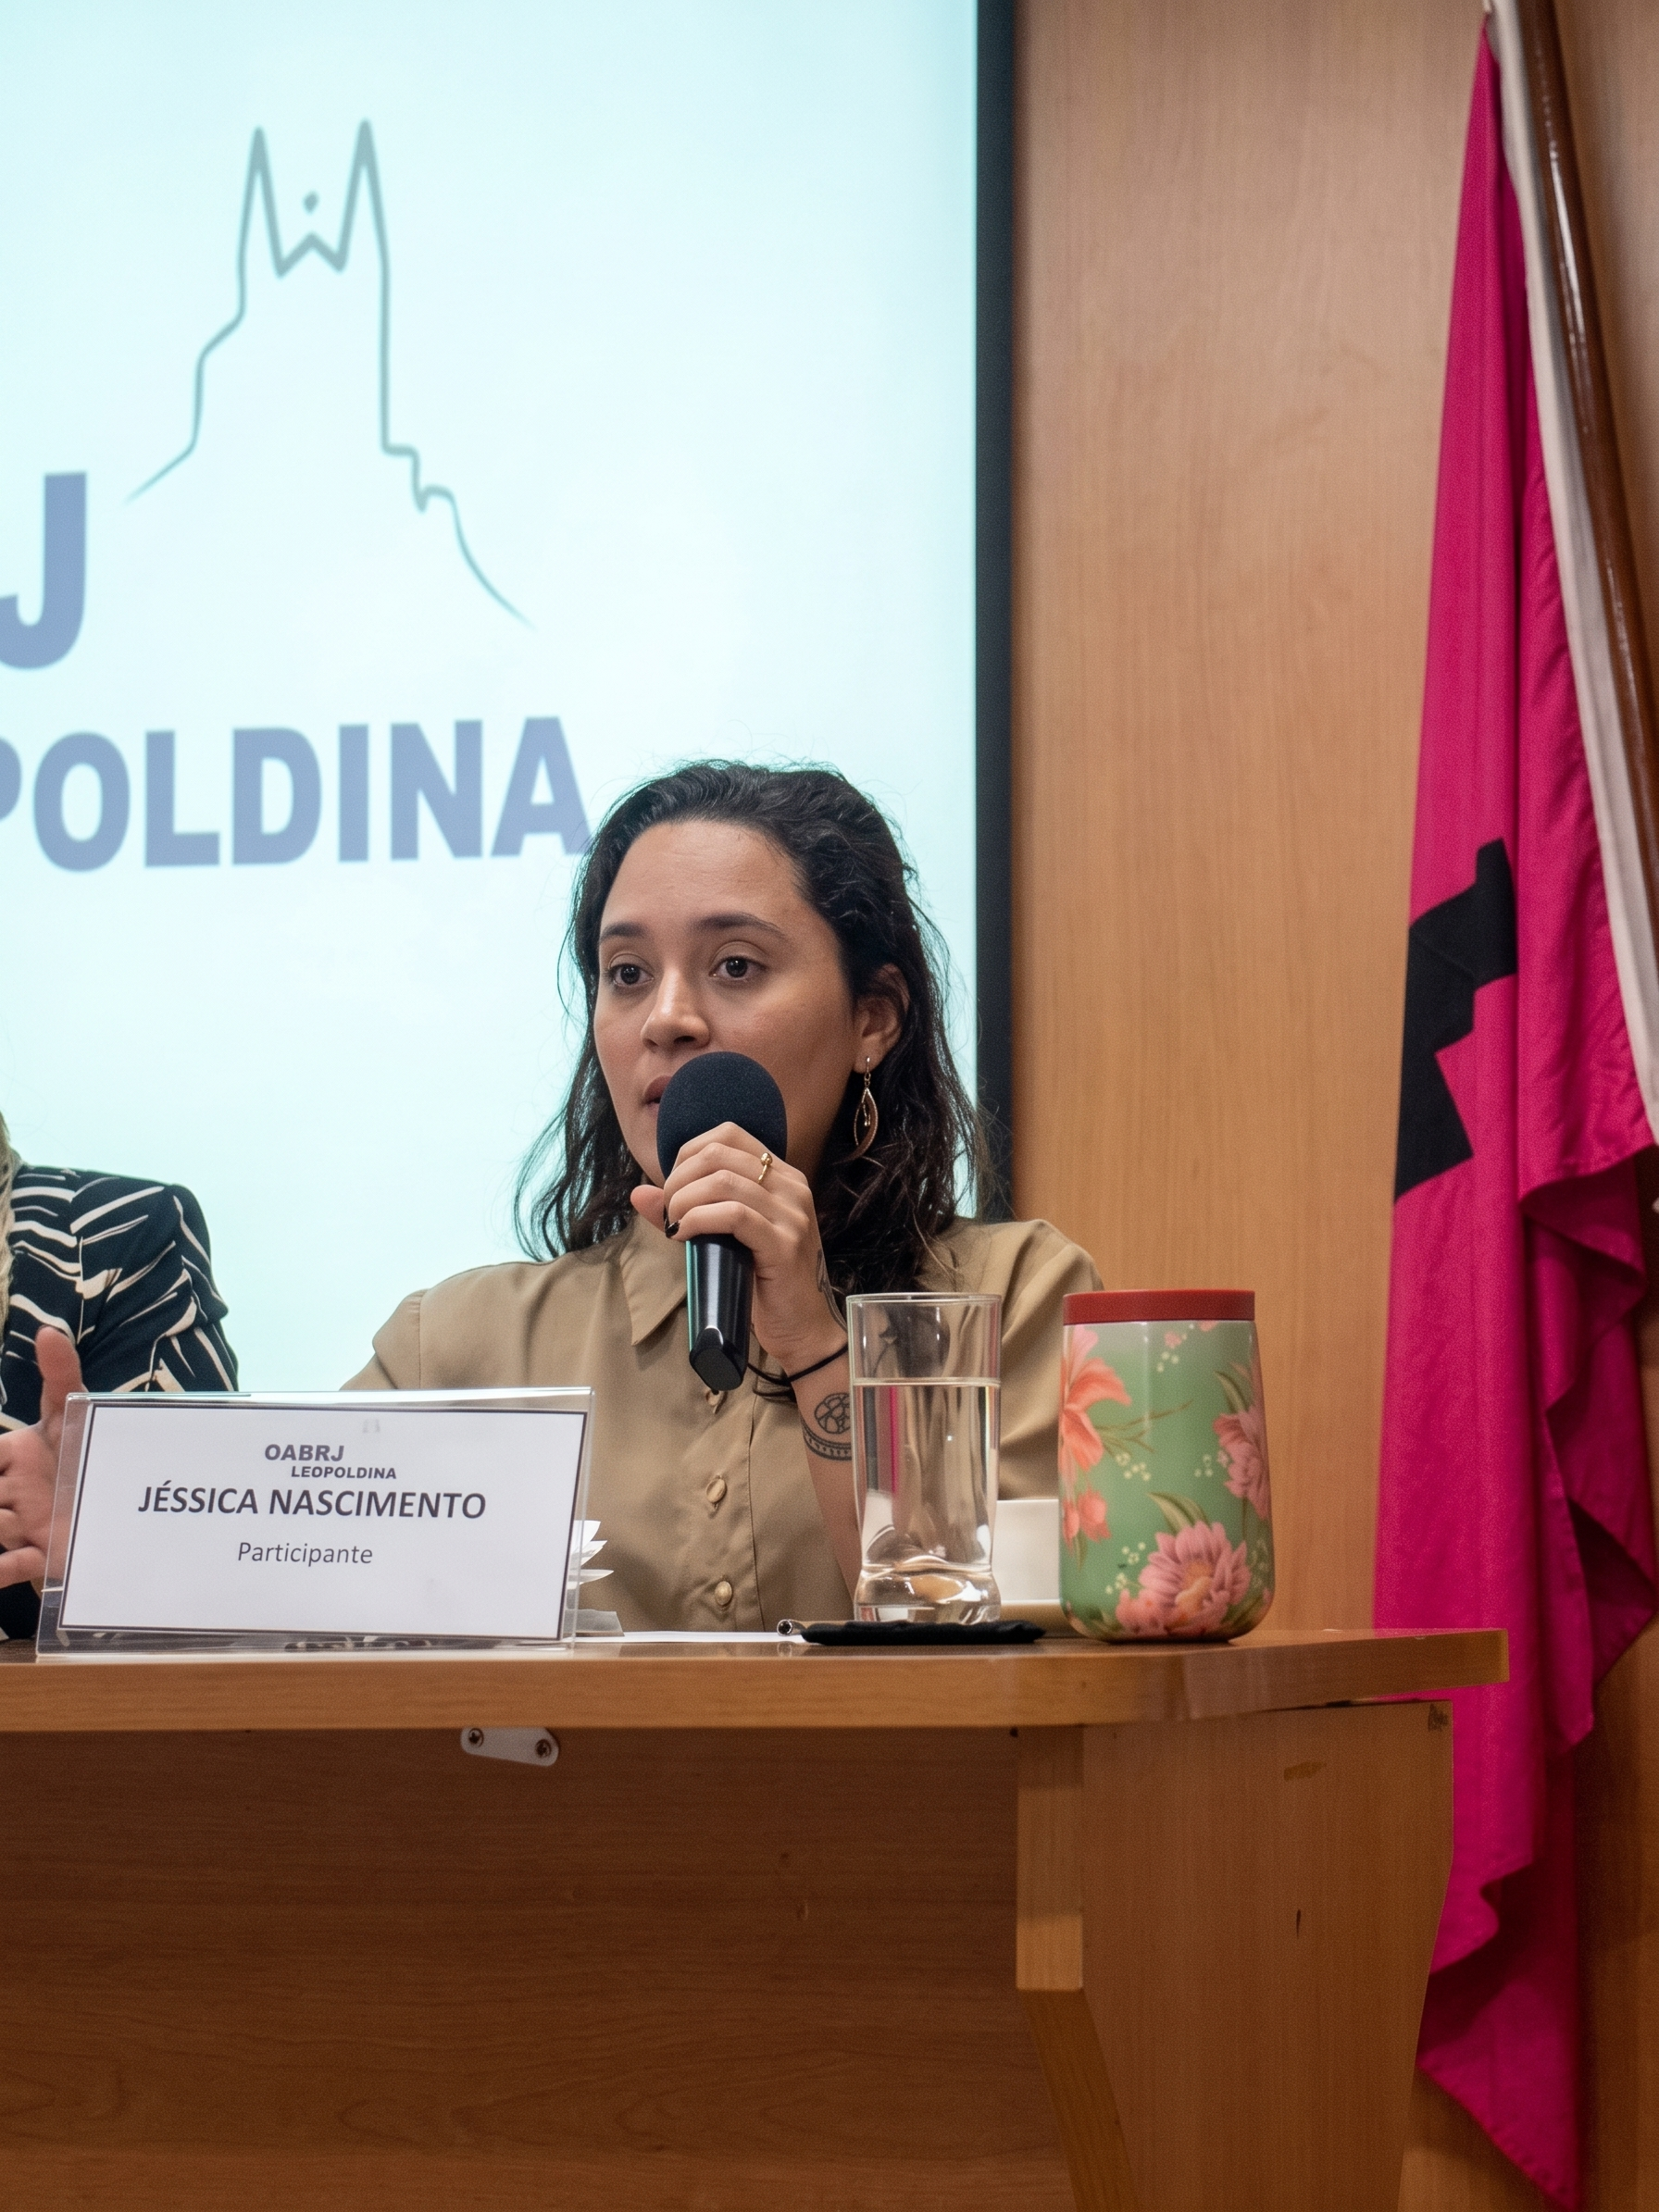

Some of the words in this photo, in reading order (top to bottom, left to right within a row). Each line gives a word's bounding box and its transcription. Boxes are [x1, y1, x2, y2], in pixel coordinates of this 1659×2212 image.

[0, 716, 592, 872] OLDINA
[264, 1444, 344, 1461] OABRJ
[291, 1466, 397, 1479] LEOPOLDINA
[138, 1481, 259, 1514] JÉSSICA
[268, 1489, 487, 1519] NASCIMENTO
[237, 1542, 373, 1567] Participante
